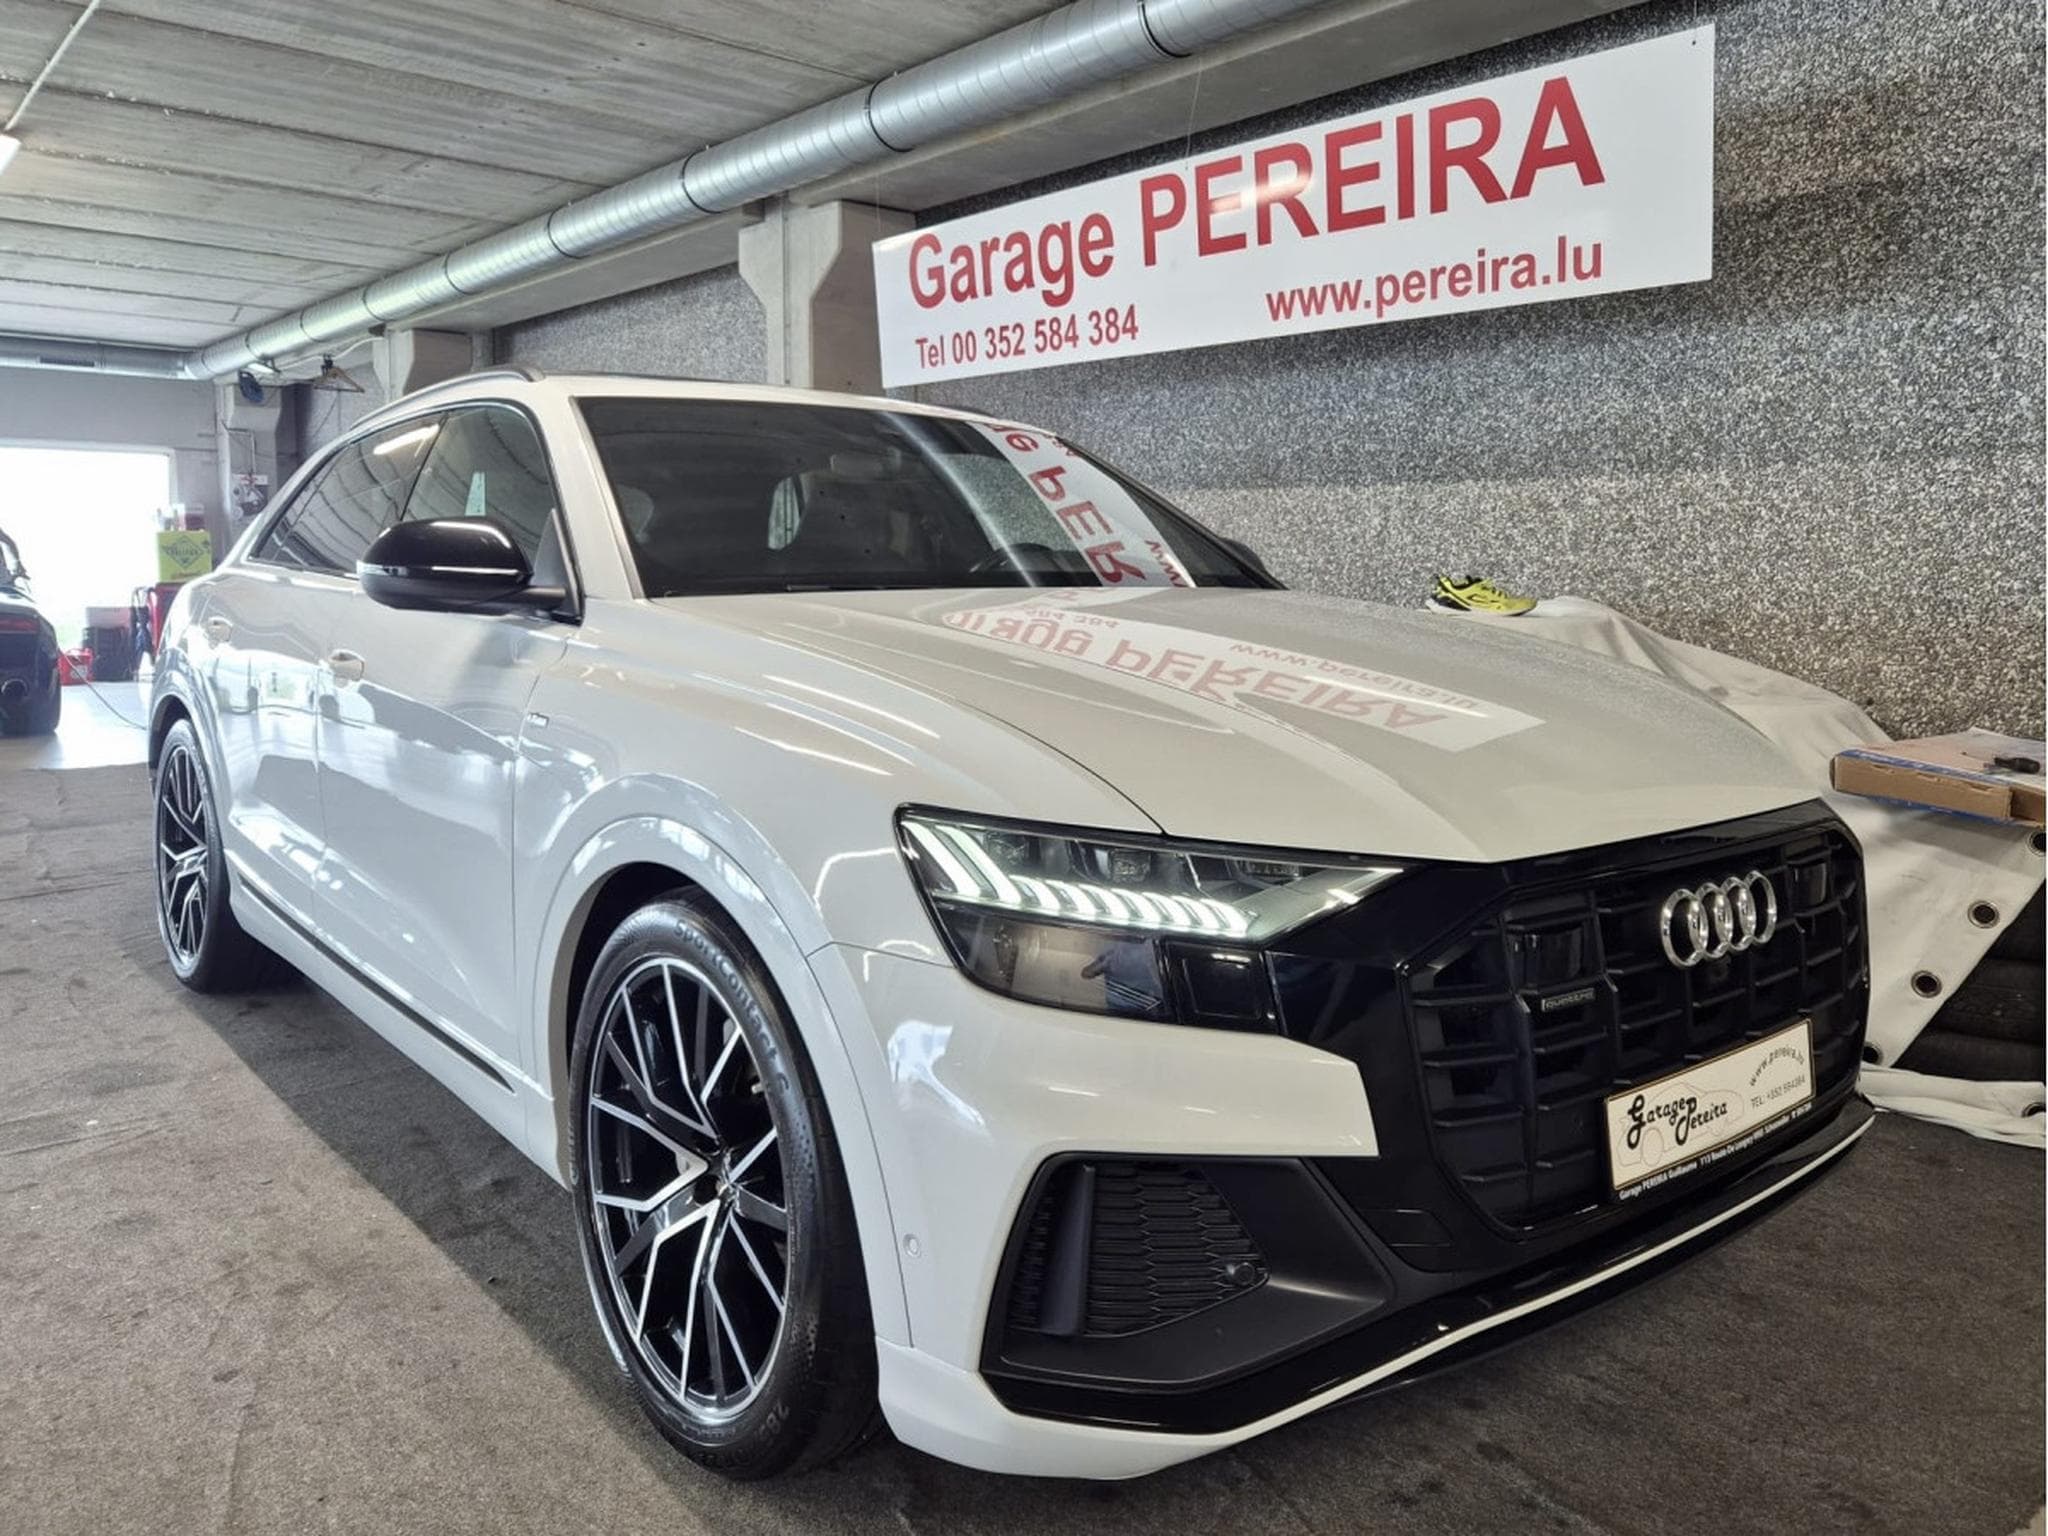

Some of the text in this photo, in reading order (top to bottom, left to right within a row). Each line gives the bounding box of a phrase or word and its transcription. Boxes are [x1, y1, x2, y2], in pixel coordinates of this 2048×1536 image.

[909, 76, 1606, 309] Garage PEREIRA
[1266, 235, 1604, 320] www.pereira.lu
[916, 304, 1140, 369] Tel 00 352 584 384
[1627, 1094, 1686, 1150] Garage
[1675, 1097, 1728, 1146] Pereira
